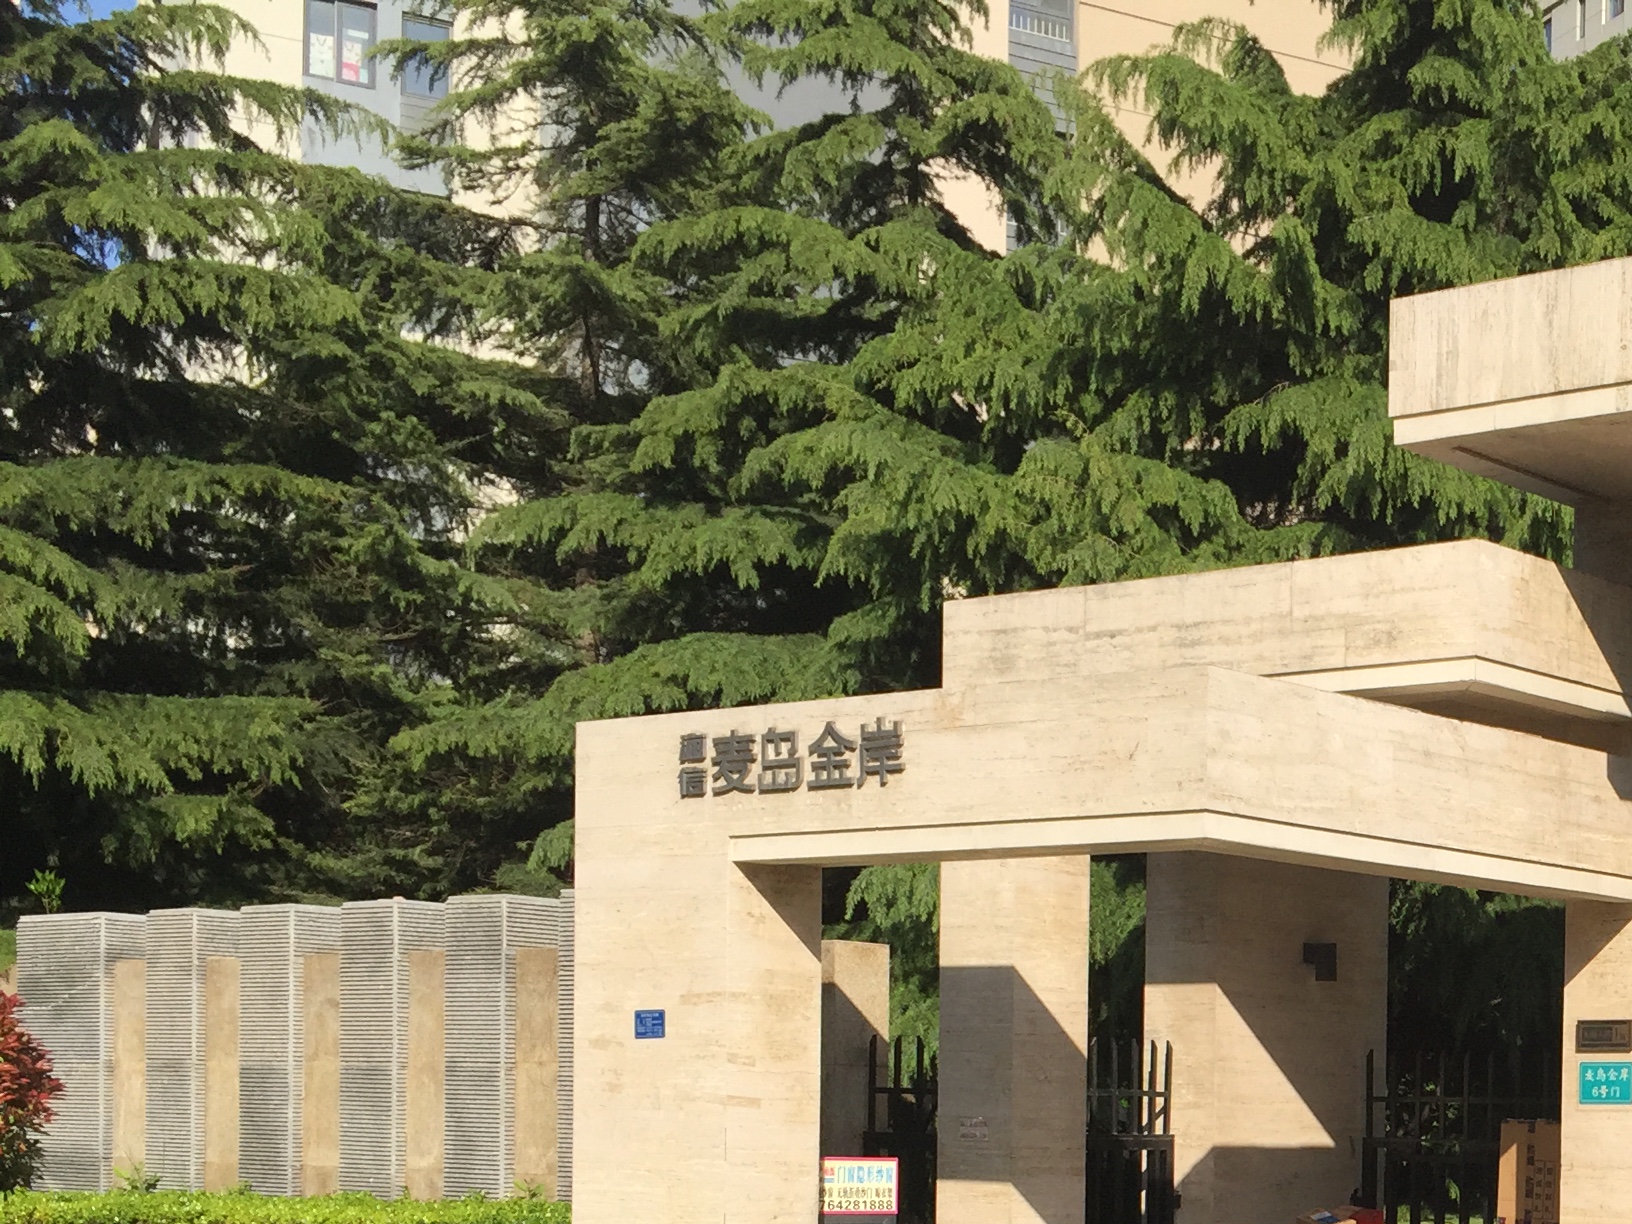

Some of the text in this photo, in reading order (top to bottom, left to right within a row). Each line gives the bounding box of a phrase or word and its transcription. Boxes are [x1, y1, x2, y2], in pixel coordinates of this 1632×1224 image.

[710, 715, 907, 798] 麦岛金岸
[1584, 1066, 1630, 1082] 麦岛金岸
[1591, 1084, 1621, 1099] 6号门
